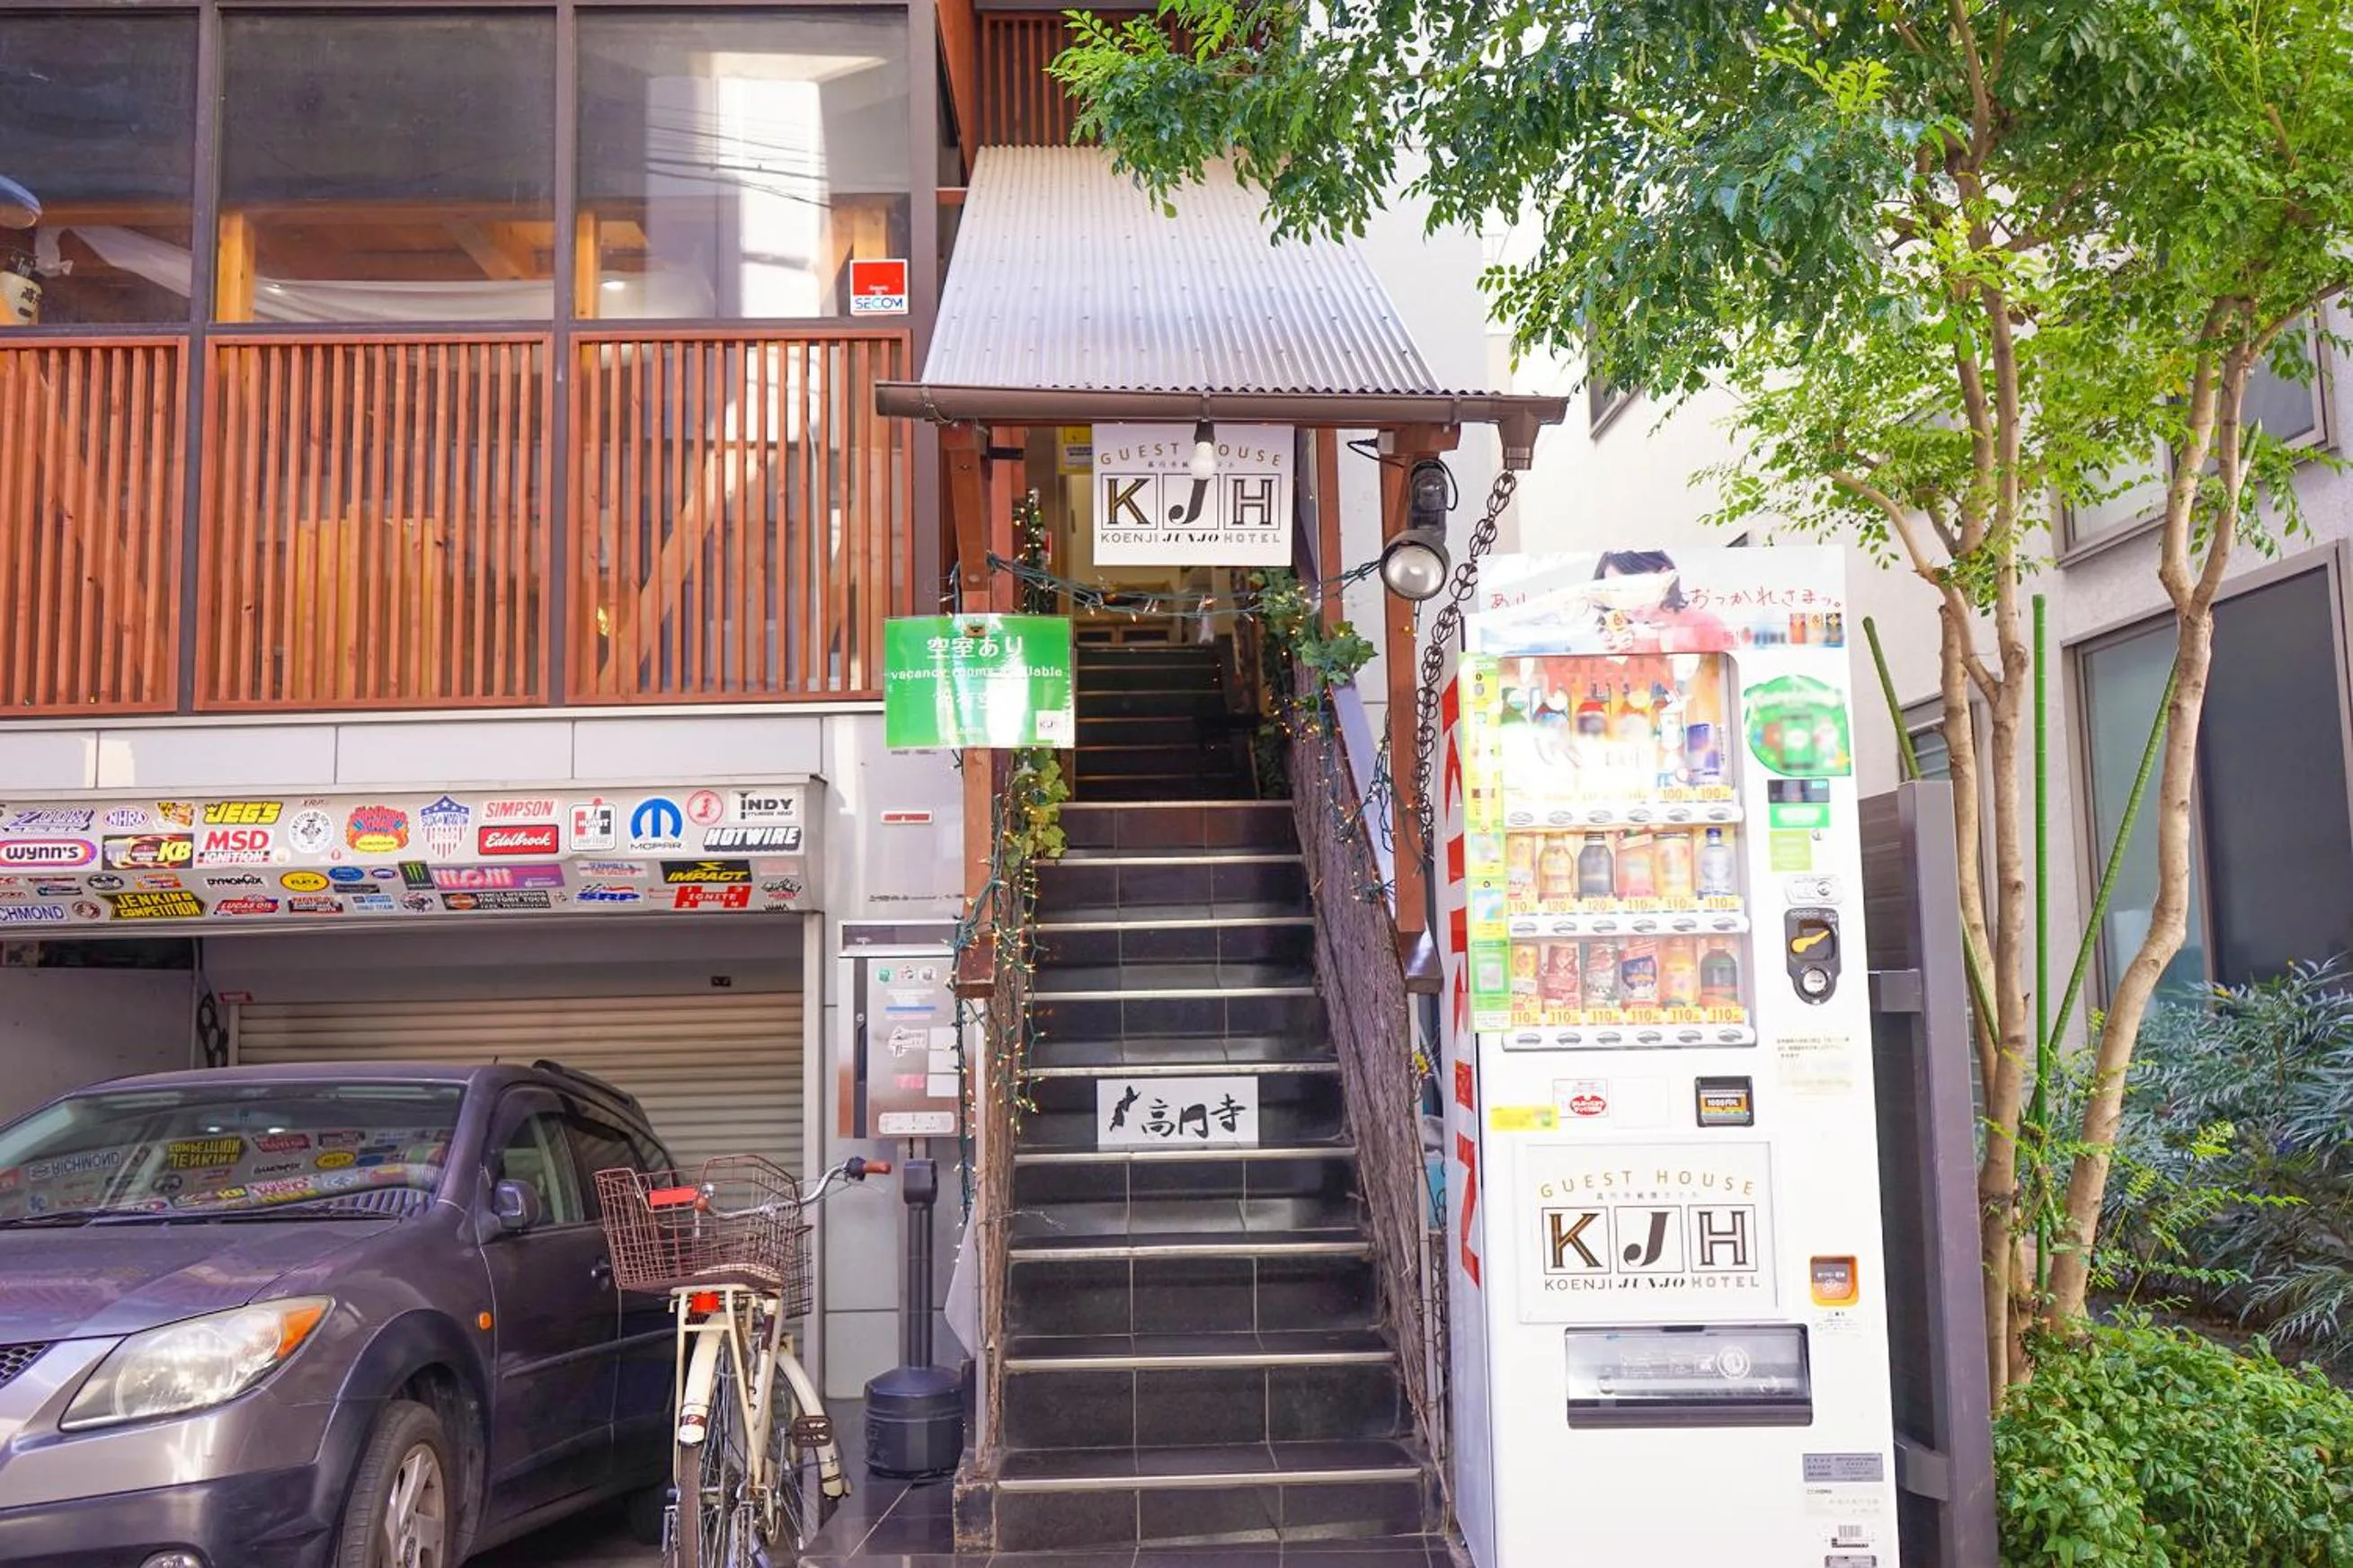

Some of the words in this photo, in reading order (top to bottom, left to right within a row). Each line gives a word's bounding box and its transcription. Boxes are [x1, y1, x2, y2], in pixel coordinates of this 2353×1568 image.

[855, 297, 903, 310] SECOM
[1100, 442, 1180, 465] GUEST
[1218, 443, 1281, 466] OUSE
[1100, 532, 1159, 543] KOENJI
[1161, 532, 1220, 543] JUNJO
[1223, 532, 1281, 543] HOTEL
[204, 802, 283, 825] JEG'S
[485, 801, 554, 819] SIMPSON
[205, 830, 270, 851] MSD
[485, 831, 551, 848] Edelbrock
[630, 842, 682, 850] MOPAR
[705, 827, 801, 850] HOTWIRE
[157, 841, 192, 862] KB
[204, 850, 264, 864] IGNITION
[666, 871, 749, 882] IMPACT
[120, 901, 201, 917] COMPETITION
[221, 901, 254, 910] LUCAS
[256, 900, 274, 909] OIL
[1141, 1093, 1247, 1139] 高円寺
[1541, 1170, 1632, 1199] GUEST
[1656, 1170, 1754, 1196] HOUSE
[1544, 1278, 1612, 1292] KOENJI
[1618, 1276, 1686, 1289] JUNJO
[1691, 1275, 1761, 1289] HOTEL
